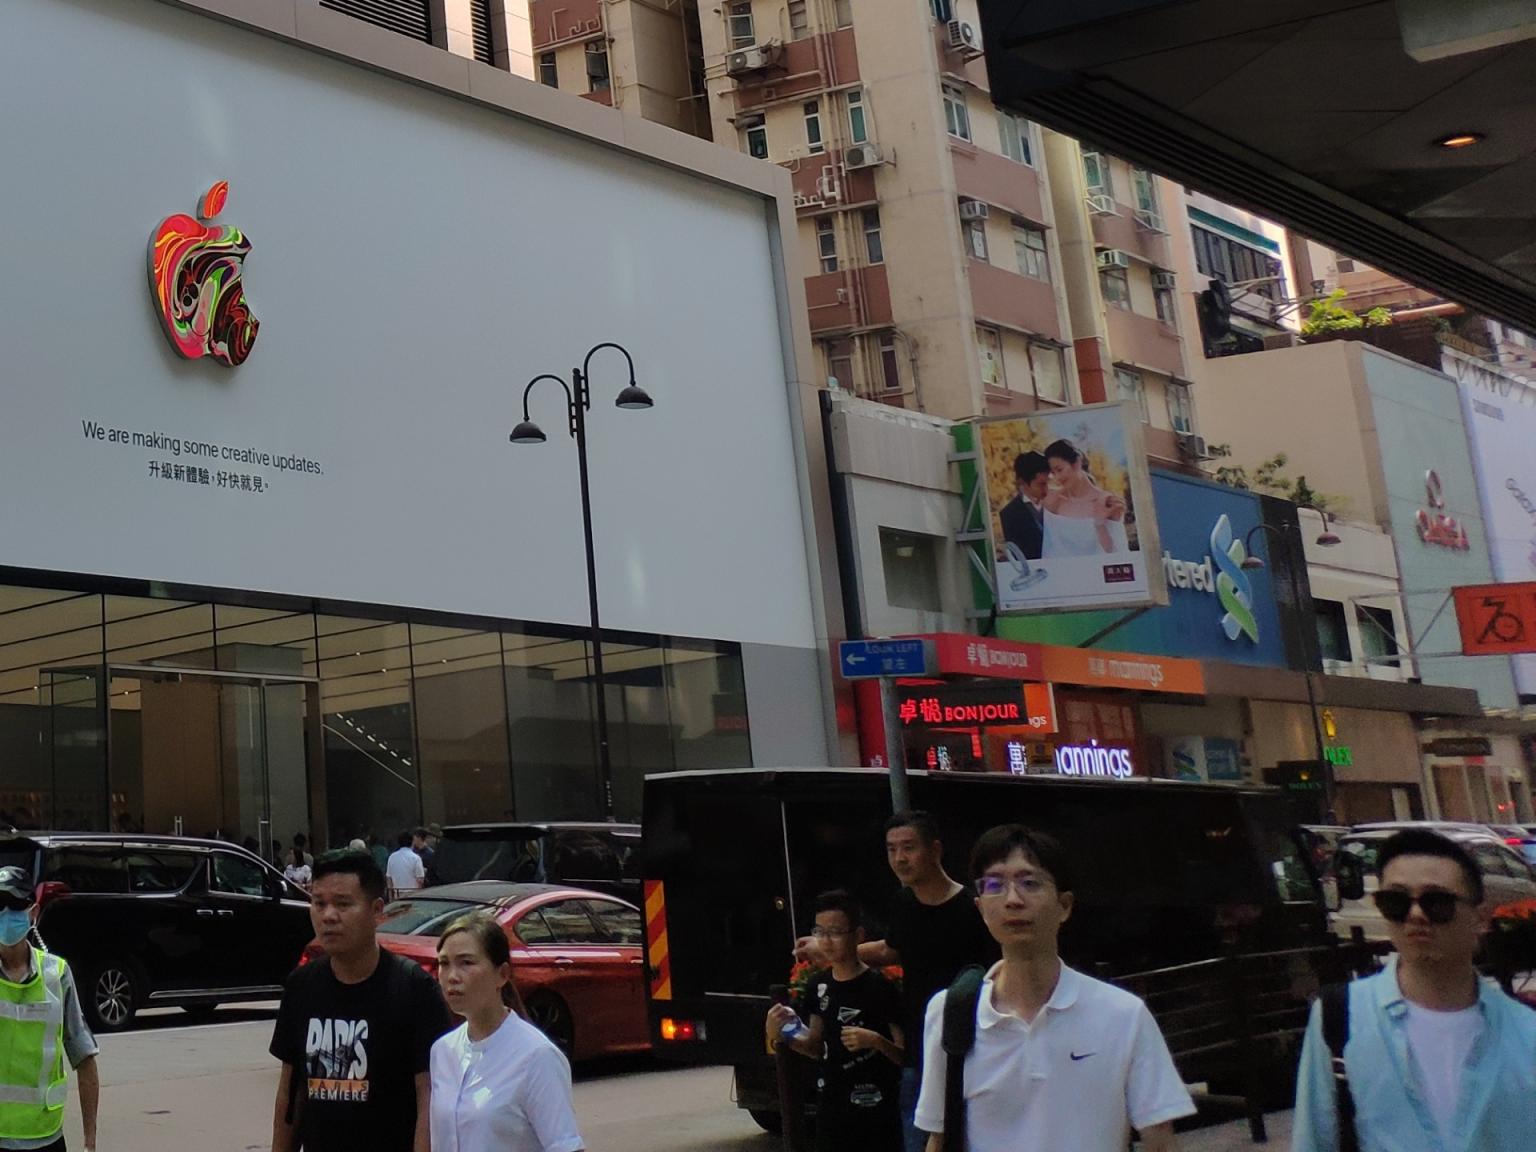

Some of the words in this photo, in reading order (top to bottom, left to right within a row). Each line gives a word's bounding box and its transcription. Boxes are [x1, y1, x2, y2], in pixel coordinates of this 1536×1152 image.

[81, 419, 106, 441] We
[108, 427, 130, 444] are
[132, 430, 181, 456] making
[183, 440, 220, 458] some
[221, 445, 271, 466] creative
[272, 454, 325, 478] updates.
[1160, 550, 1216, 593] tered
[1108, 659, 1164, 687] mannings
[945, 703, 1020, 724] BONJOUR
[1055, 738, 1134, 779] annings
[305, 1017, 369, 1080] PARIS
[308, 1089, 369, 1102] PREMIERE
